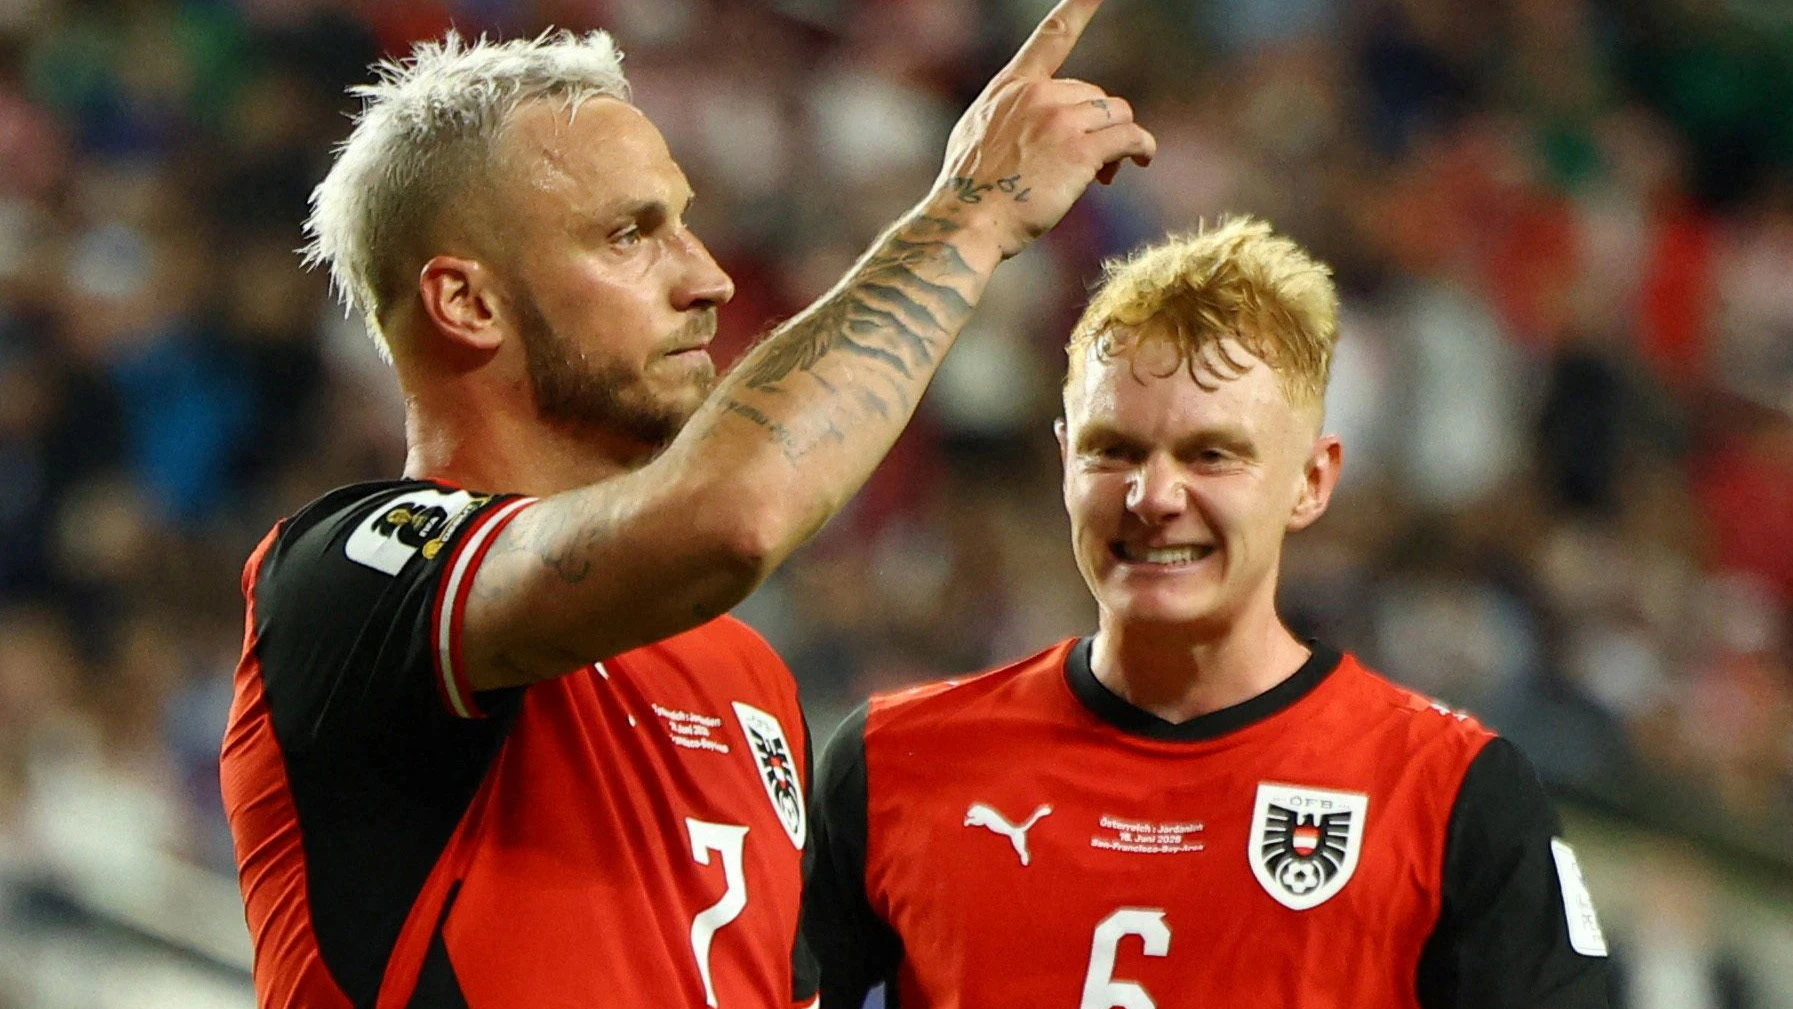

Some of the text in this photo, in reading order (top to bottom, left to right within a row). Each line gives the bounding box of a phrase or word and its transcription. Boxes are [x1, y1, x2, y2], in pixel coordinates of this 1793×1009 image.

[1289, 795, 1334, 810] ÖFB
[1099, 816, 1151, 833] Österreich
[1134, 833, 1156, 843] Juni
[685, 816, 750, 1008] 7
[1079, 907, 1171, 1009] 6
